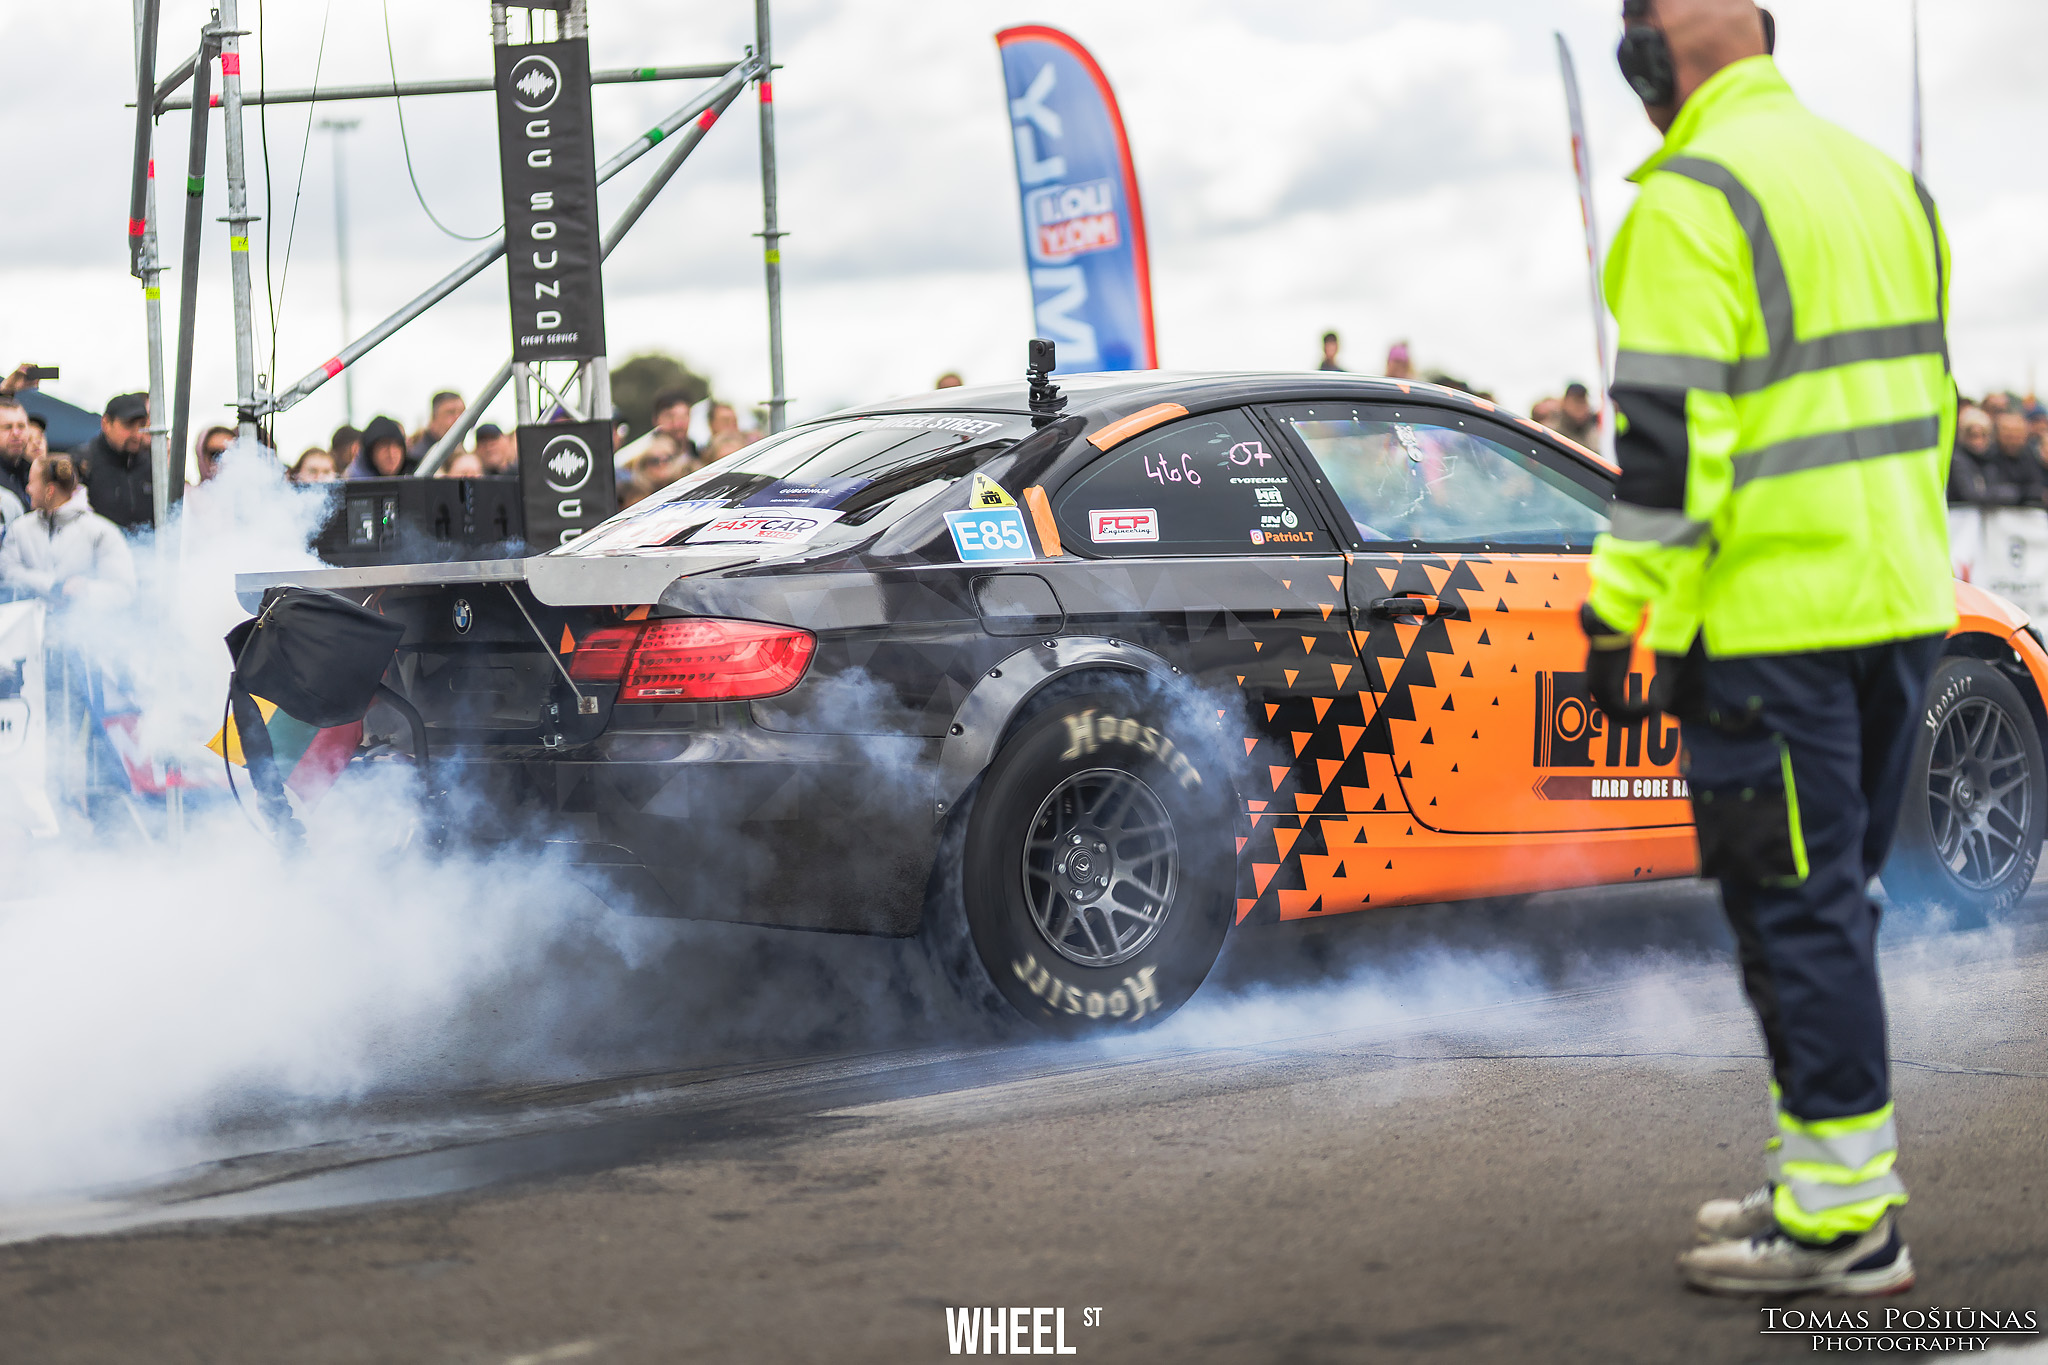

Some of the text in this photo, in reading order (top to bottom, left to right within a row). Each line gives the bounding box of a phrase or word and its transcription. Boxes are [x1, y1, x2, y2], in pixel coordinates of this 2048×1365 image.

[530, 191, 562, 329] SOUND
[547, 332, 579, 344] SERVICE
[927, 417, 1004, 435] STREET
[1229, 441, 1272, 467] 07
[1099, 515, 1150, 534] FCP
[1102, 526, 1153, 536] Engineering
[760, 530, 797, 539] SHOP
[954, 520, 1024, 551] E85
[1264, 531, 1314, 543] PatrioLT
[1592, 779, 1629, 798] HARD
[1633, 779, 1668, 798] CORE
